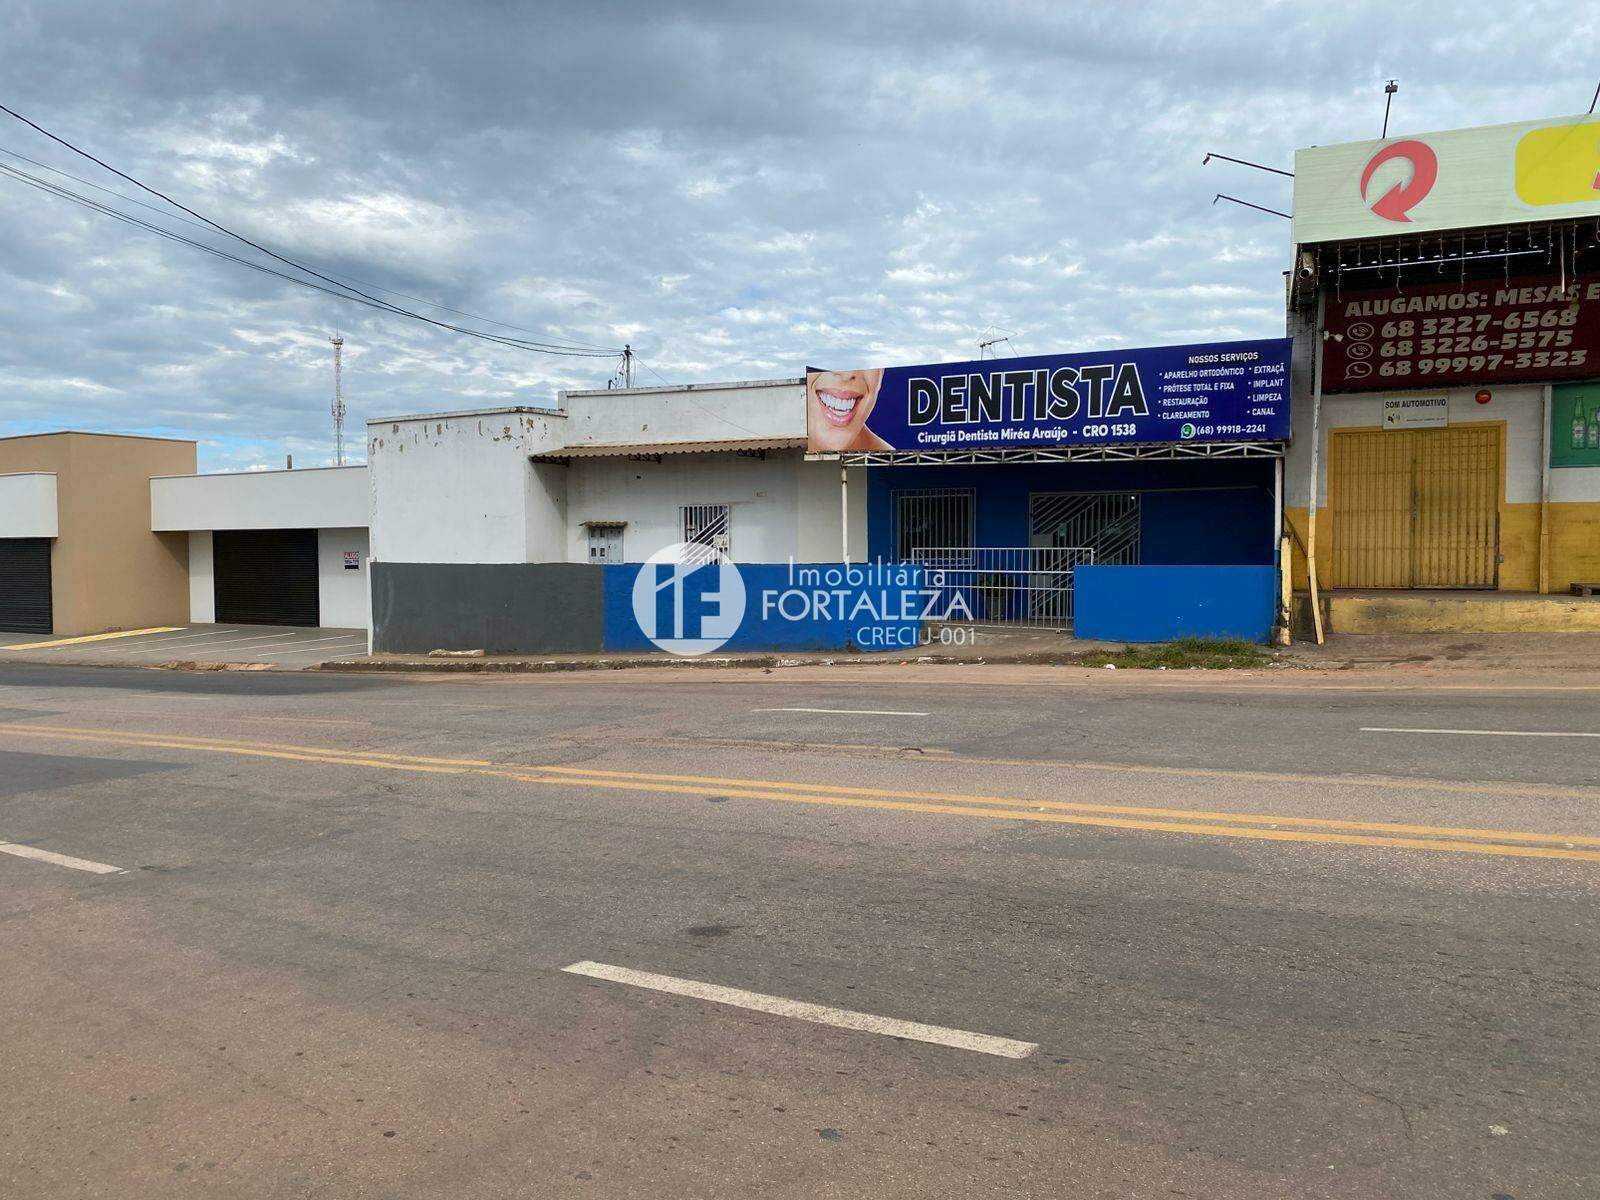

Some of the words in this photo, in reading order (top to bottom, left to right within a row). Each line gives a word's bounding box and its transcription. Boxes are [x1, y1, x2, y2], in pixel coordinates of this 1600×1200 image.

[1345, 292, 1488, 317] ALUGAMOS:
[1495, 284, 1581, 305] MESAS
[1381, 320, 1415, 338] 68
[1421, 309, 1577, 335] 3227-6568
[1380, 339, 1414, 357] 68
[1420, 330, 1573, 355] 3226-5375
[1188, 355, 1219, 364] NOSSOS
[1220, 352, 1259, 362] SERVIÇOS
[1379, 360, 1412, 377] 68
[1418, 350, 1588, 374] 99997-3323
[1164, 370, 1198, 379] APARELHO
[1163, 384, 1192, 392] PRÓTESE
[1194, 382, 1213, 391] TOTAL
[1214, 382, 1219, 390] E
[1220, 382, 1235, 390] FIXA
[908, 363, 1149, 426] DENTISTA
[1252, 393, 1282, 402] LIMPEZA
[1163, 396, 1208, 406] RESTAURAÇÃO
[1384, 401, 1400, 409] SOM
[1401, 398, 1447, 408] AUTOMOTIVO
[1162, 410, 1210, 419] CLAREAMENTO
[1252, 407, 1275, 416] CANAL
[917, 431, 956, 445] Cirurgiã
[957, 430, 999, 442] Dentista
[1000, 428, 1030, 441] Miréa
[1031, 426, 1068, 442] Araújo
[1082, 424, 1109, 438] CRO
[1110, 423, 1137, 437] 1538
[1196, 425, 1214, 435] (68)
[1216, 424, 1266, 435] 99918-2241
